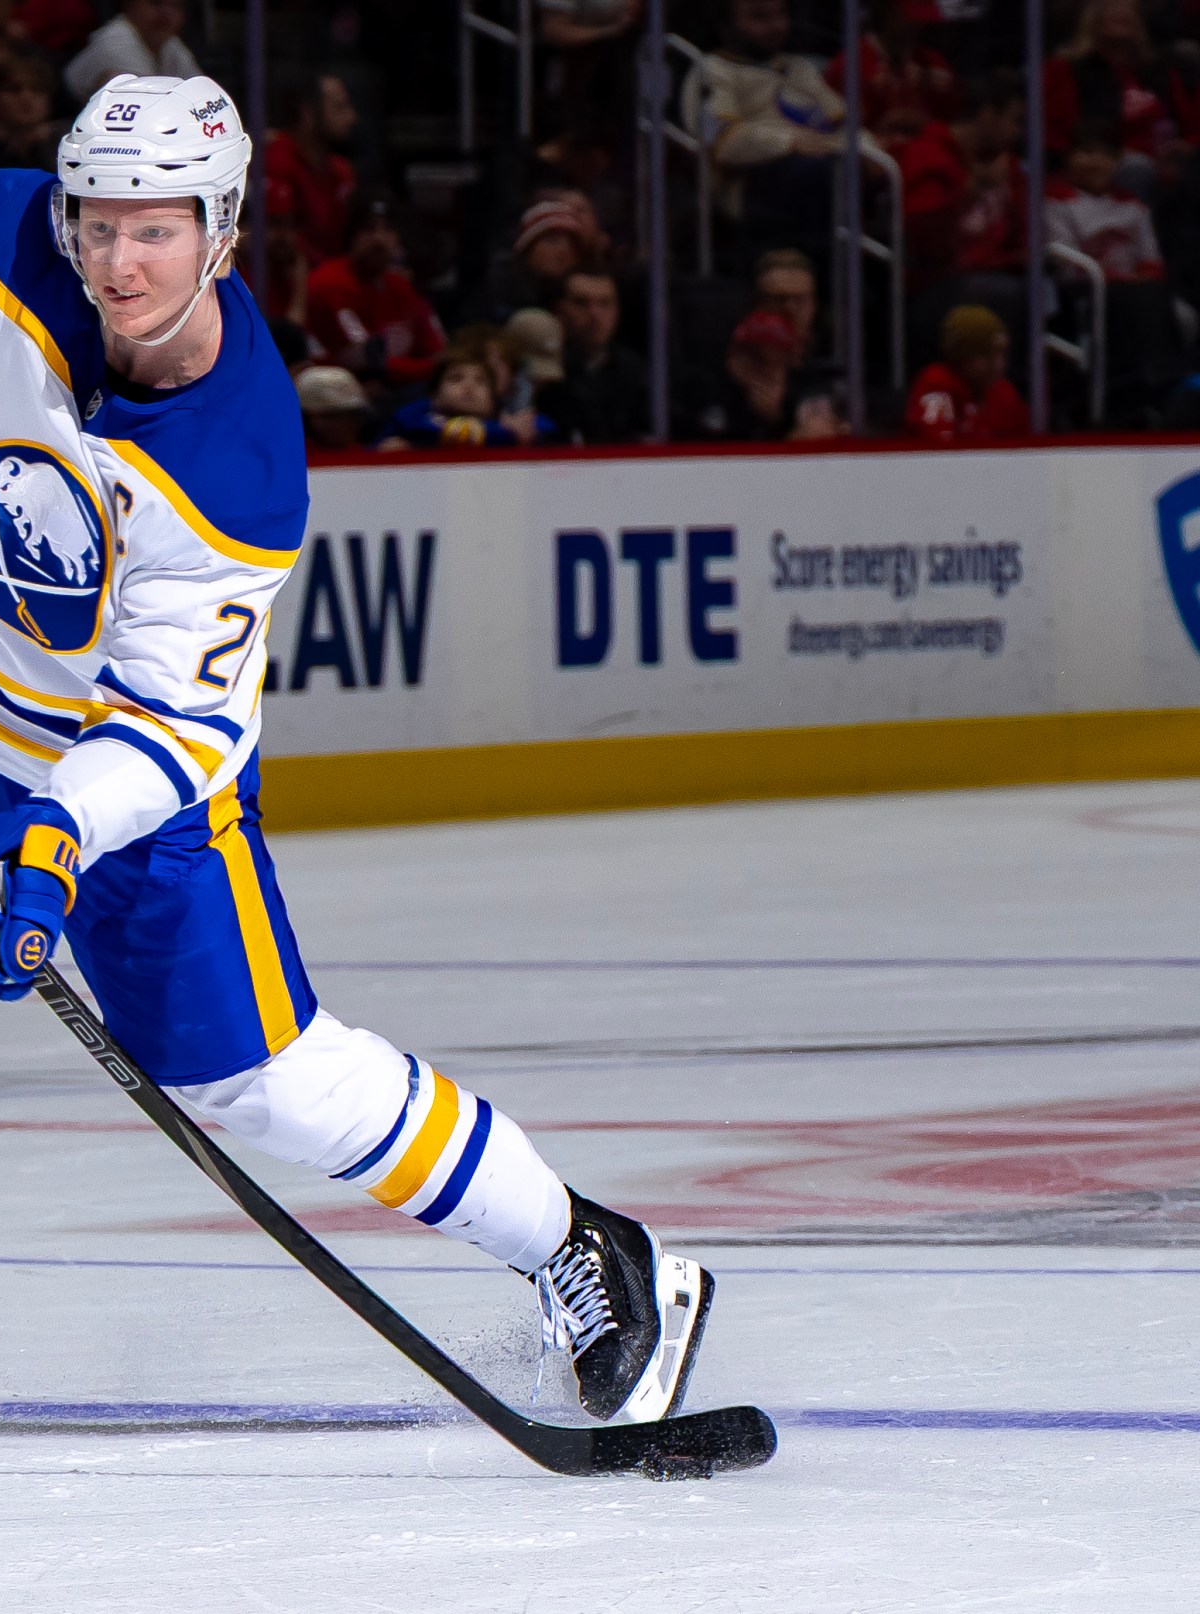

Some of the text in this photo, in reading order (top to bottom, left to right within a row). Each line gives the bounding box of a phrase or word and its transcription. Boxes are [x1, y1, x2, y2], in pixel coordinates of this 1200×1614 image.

[89, 147, 142, 156] WARRIOR
[104, 103, 142, 122] 26
[264, 528, 437, 695] AW
[555, 527, 739, 670] DTE
[194, 600, 270, 705] 2
